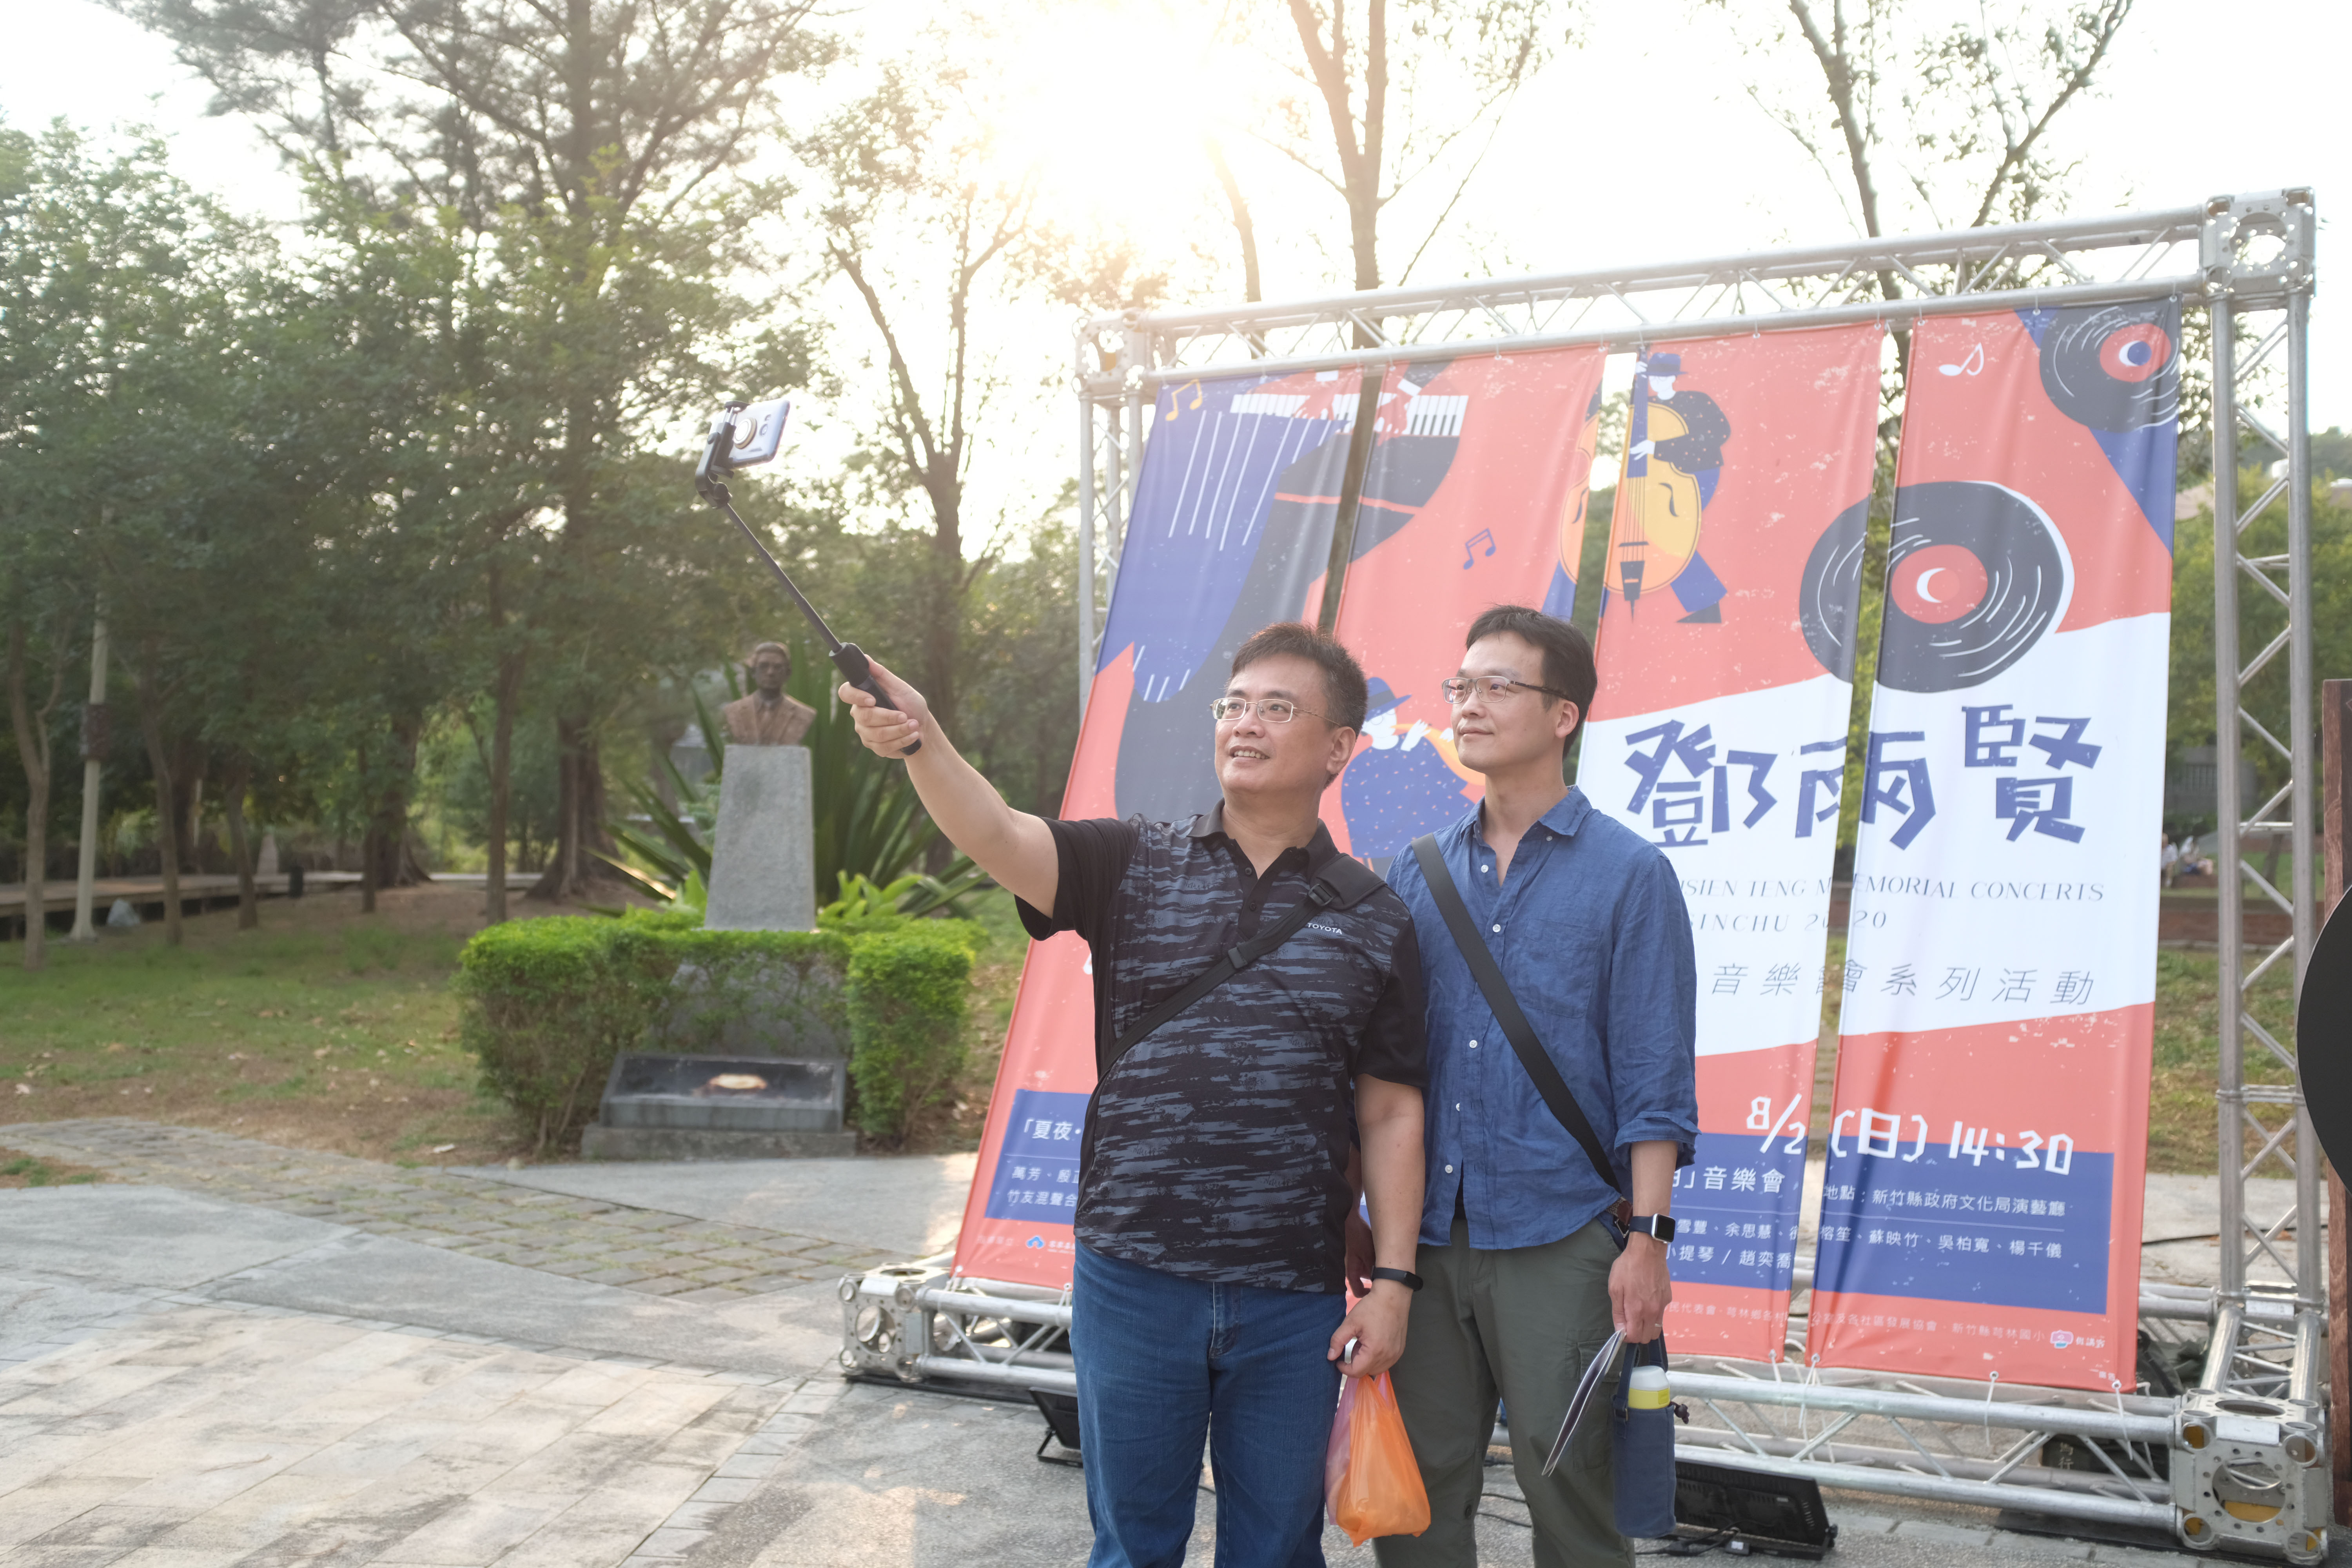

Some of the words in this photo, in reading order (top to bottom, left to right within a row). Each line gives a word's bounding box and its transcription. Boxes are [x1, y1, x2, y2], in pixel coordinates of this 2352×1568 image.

[1624, 704, 2102, 851] 鄧雨賢
[1748, 880, 1806, 897] TENG
[1971, 881, 2103, 902] CONCERTS
[1307, 922, 1343, 935] TOYOTA
[1711, 959, 2094, 1005] 音樂會系列活動
[1746, 1094, 1806, 1155] 8/2
[1948, 1121, 2074, 1175] 14:30
